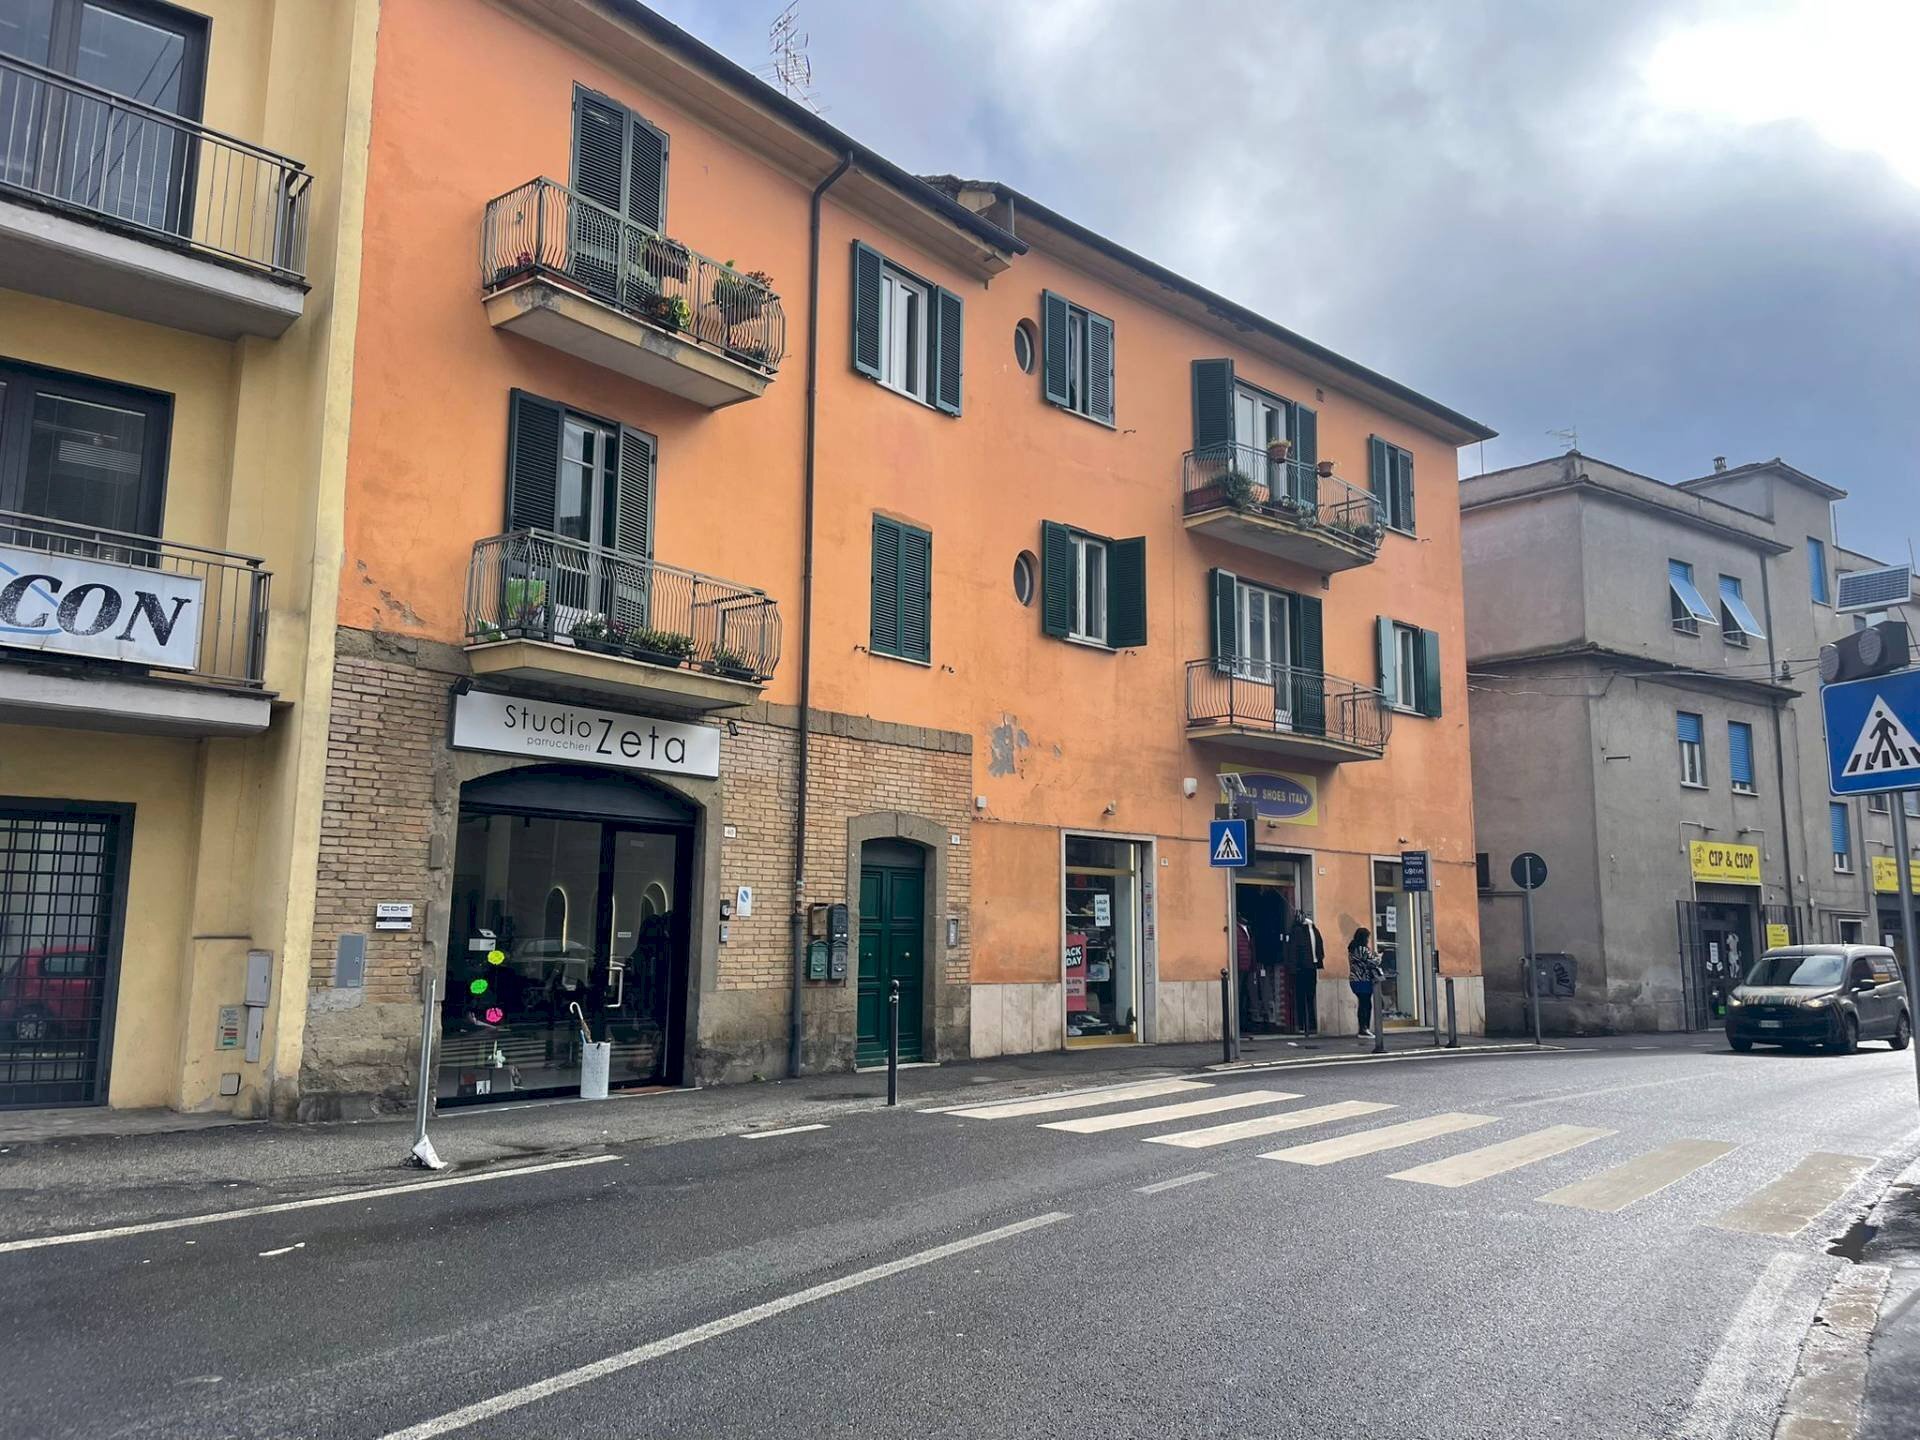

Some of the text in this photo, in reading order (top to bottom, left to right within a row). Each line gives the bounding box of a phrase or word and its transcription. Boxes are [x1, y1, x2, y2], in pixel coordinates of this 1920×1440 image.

[0, 574, 192, 646] CON
[504, 704, 686, 764] Studio Zeta
[527, 735, 591, 752] parrucchieri
[1262, 788, 1287, 802] SHOES
[1288, 792, 1308, 805] ITALY
[1708, 850, 1723, 867] CIP
[1726, 850, 1733, 867] &
[1734, 852, 1754, 869] CIOP
[1066, 956, 1083, 967] DAY
